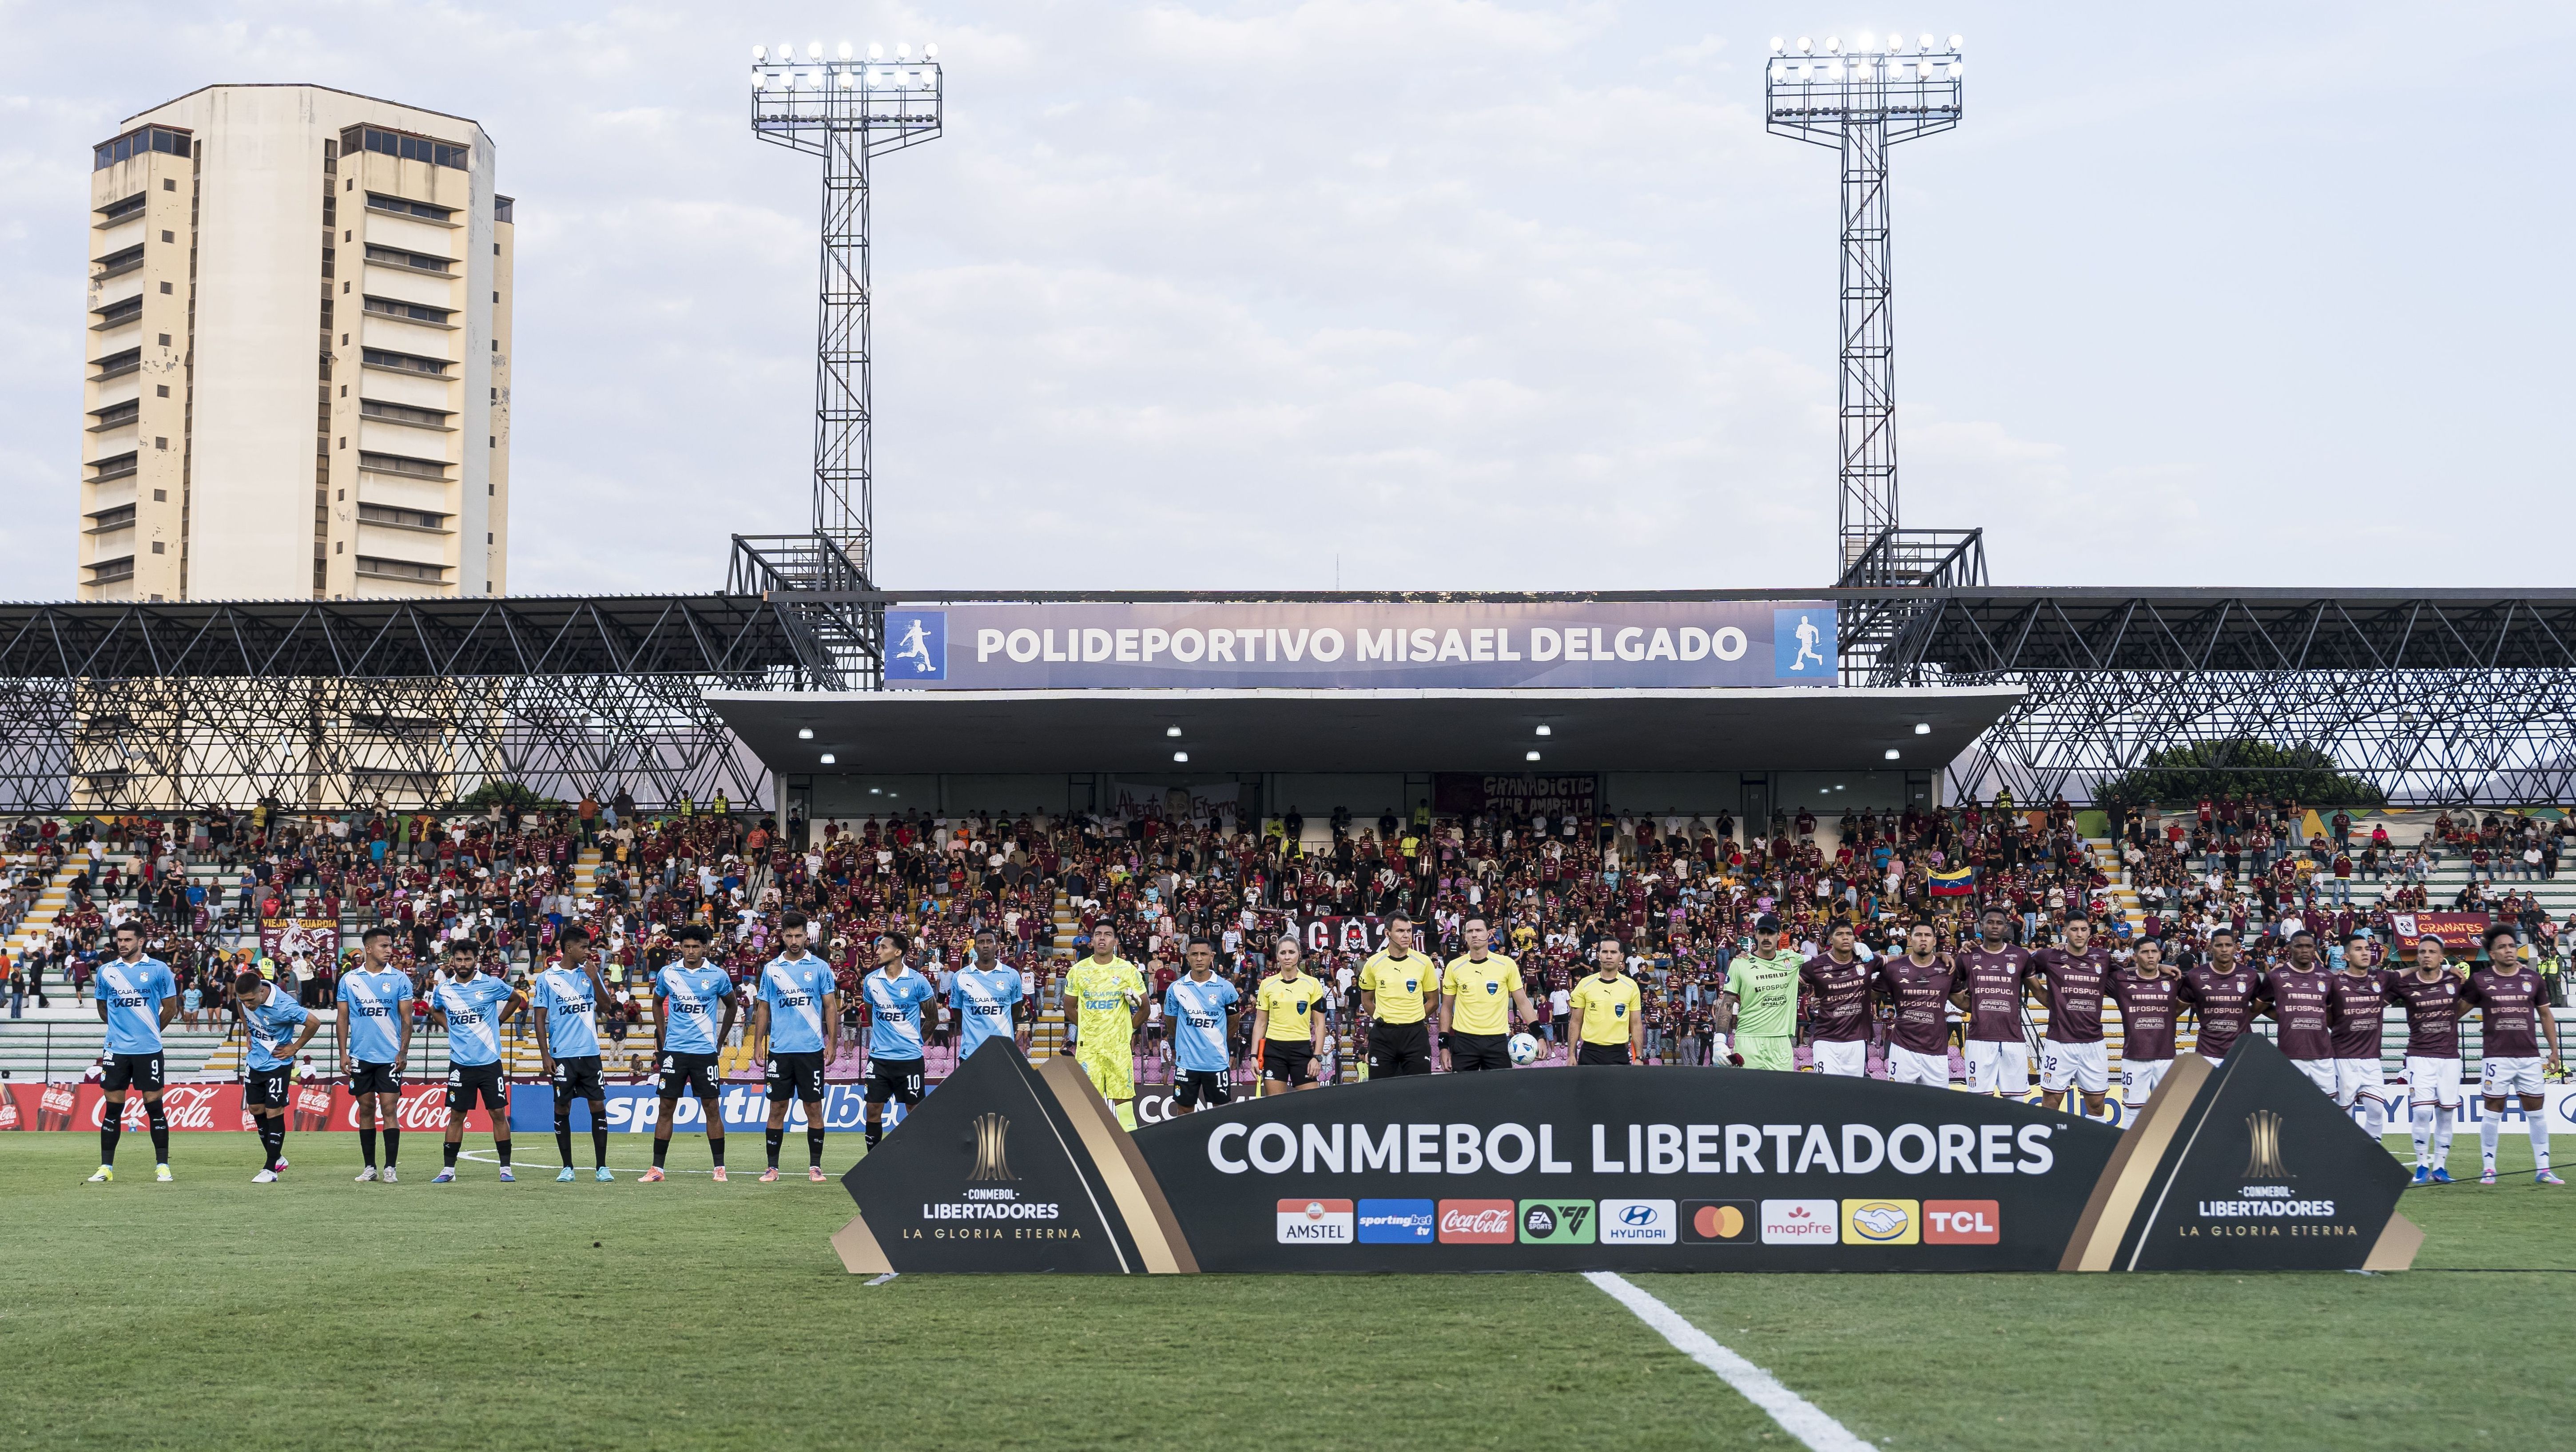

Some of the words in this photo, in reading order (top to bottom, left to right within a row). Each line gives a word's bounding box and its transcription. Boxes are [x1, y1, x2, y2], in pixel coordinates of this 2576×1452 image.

[978, 627, 1345, 663] POLIDEPORTIVO
[1356, 627, 1521, 662] MISAEL
[1530, 626, 1748, 662] DELGADO
[262, 919, 287, 928] VIEJA
[299, 919, 337, 928] GUARDIA
[2418, 923, 2484, 933] GRANATES
[1308, 921, 1328, 952] G
[1756, 972, 1788, 980] FRIGILUX
[2064, 974, 2100, 983] FRIGILUX
[1828, 979, 1864, 989] FRIGILUX
[2069, 987, 2100, 996] FOSPUCA
[113, 997, 150, 1008] 1XBET
[673, 1003, 708, 1014] 1XBET
[778, 996, 813, 1008] 1XBET
[1085, 999, 1121, 1010] 1XBET
[358, 1007, 391, 1017] 1XBET
[558, 1002, 593, 1016] 1XBET
[970, 1005, 1005, 1016] 1XBET
[449, 1014, 485, 1025] 1XBET
[875, 1011, 909, 1022] 1XBET
[1185, 1017, 1218, 1029] 1XBET
[151, 1059, 159, 1075] 9
[1890, 1061, 1897, 1075] 3
[1969, 1061, 1976, 1074] 9
[2044, 1055, 2057, 1071] 32
[707, 1065, 719, 1081] 90
[2485, 1063, 2496, 1077] 15
[497, 1076, 505, 1092] 8
[814, 1070, 820, 1086] 5
[906, 1074, 921, 1090] 10
[1216, 1071, 1229, 1088] 19
[2122, 1071, 2132, 1086] 26
[269, 1077, 282, 1093] 21
[1207, 1122, 1573, 1174] CONMEBOL
[1592, 1123, 2054, 1174] LIBERTADORES
[923, 1203, 1059, 1219] LIBERTADORES
[2199, 1200, 2335, 1217] LIBERTADORES
[1359, 1214, 1433, 1227] sportingbet
[1441, 1209, 1512, 1233] Coca-Cola
[1529, 1211, 1552, 1223] EA
[1929, 1211, 1993, 1232] TCL
[904, 1228, 922, 1239] LA
[935, 1228, 1003, 1239] GLORIA
[1015, 1228, 1082, 1239] ETERNA
[1286, 1225, 1345, 1238] AMSTEL
[1610, 1229, 1666, 1238] HYUNDAI
[1767, 1221, 1832, 1236] mapfre
[2180, 1226, 2200, 1236] LA
[2211, 1226, 2280, 1236] GLORIA
[2291, 1226, 2358, 1236] ETERNA
